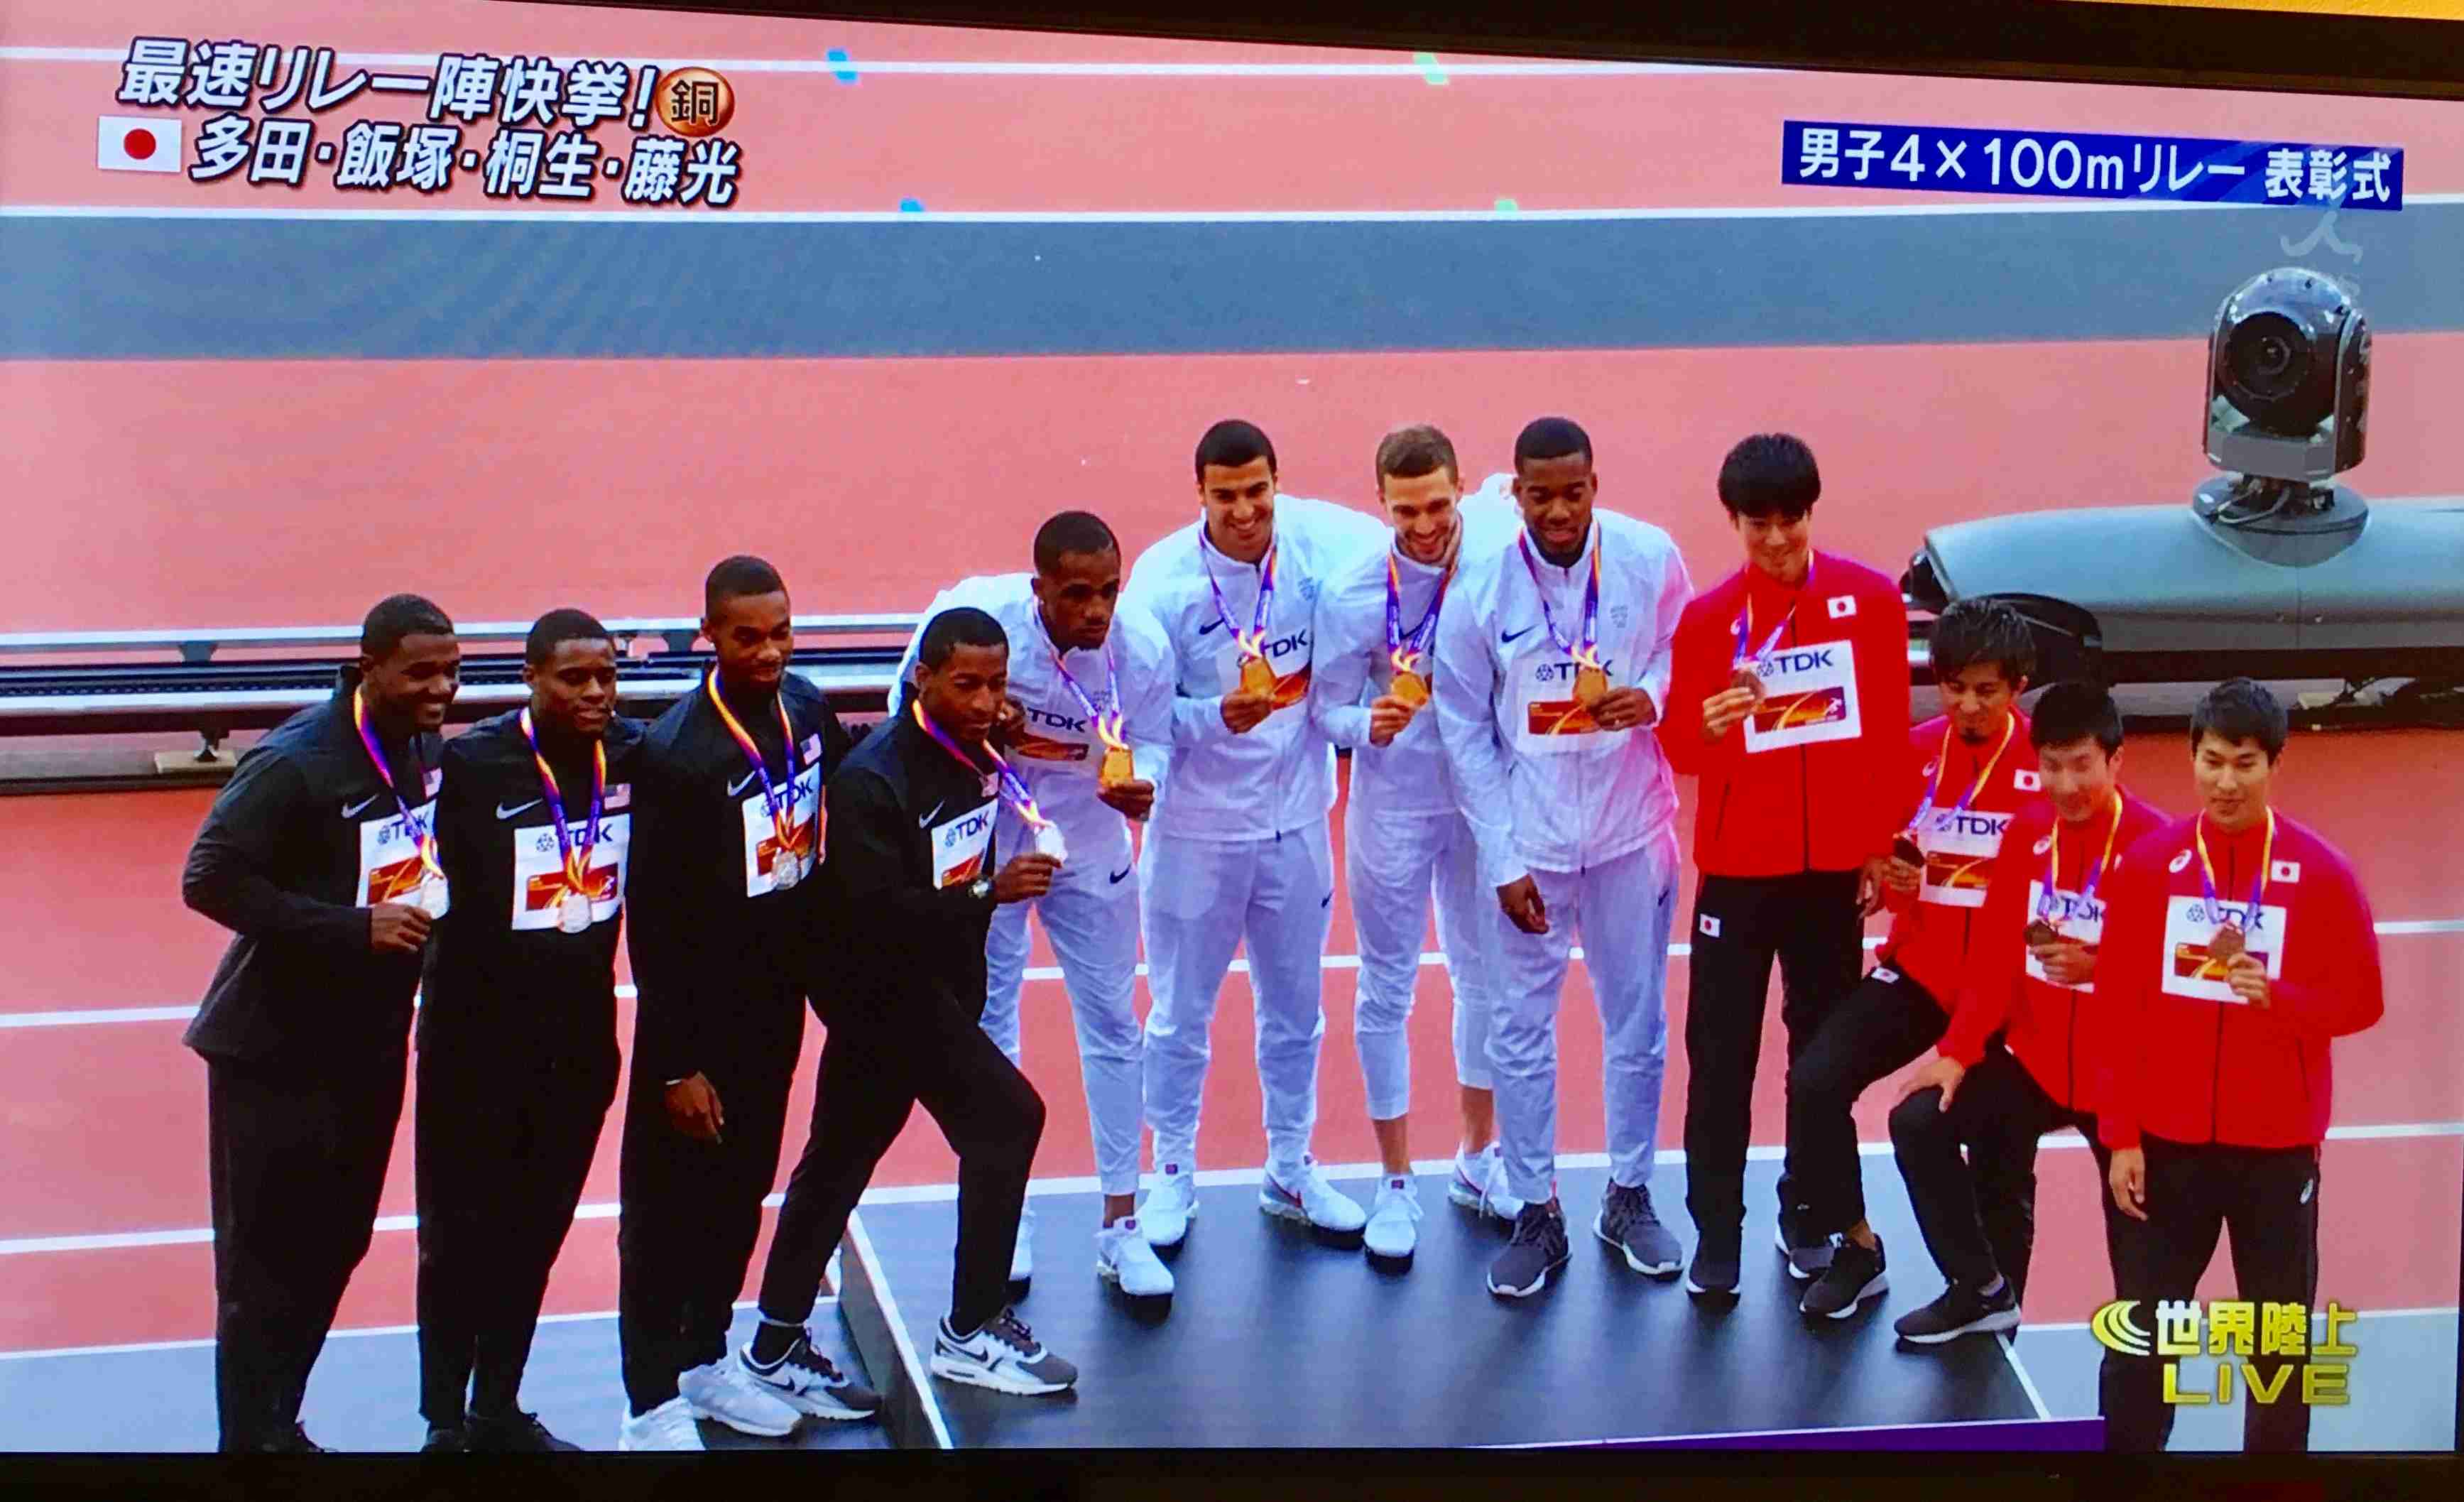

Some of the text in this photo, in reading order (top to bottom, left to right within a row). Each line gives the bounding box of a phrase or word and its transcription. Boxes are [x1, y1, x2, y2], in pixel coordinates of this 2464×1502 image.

[2264, 148, 2392, 202] 表彰式
[1779, 649, 1833, 674] TDK
[1027, 707, 1087, 733] TDK
[391, 811, 429, 840] TK
[956, 810, 990, 841] TDK
[1956, 815, 2009, 836] TDK
[2156, 1300, 2358, 1356] 世界陸上
[2163, 1364, 2350, 1405] LIVE
